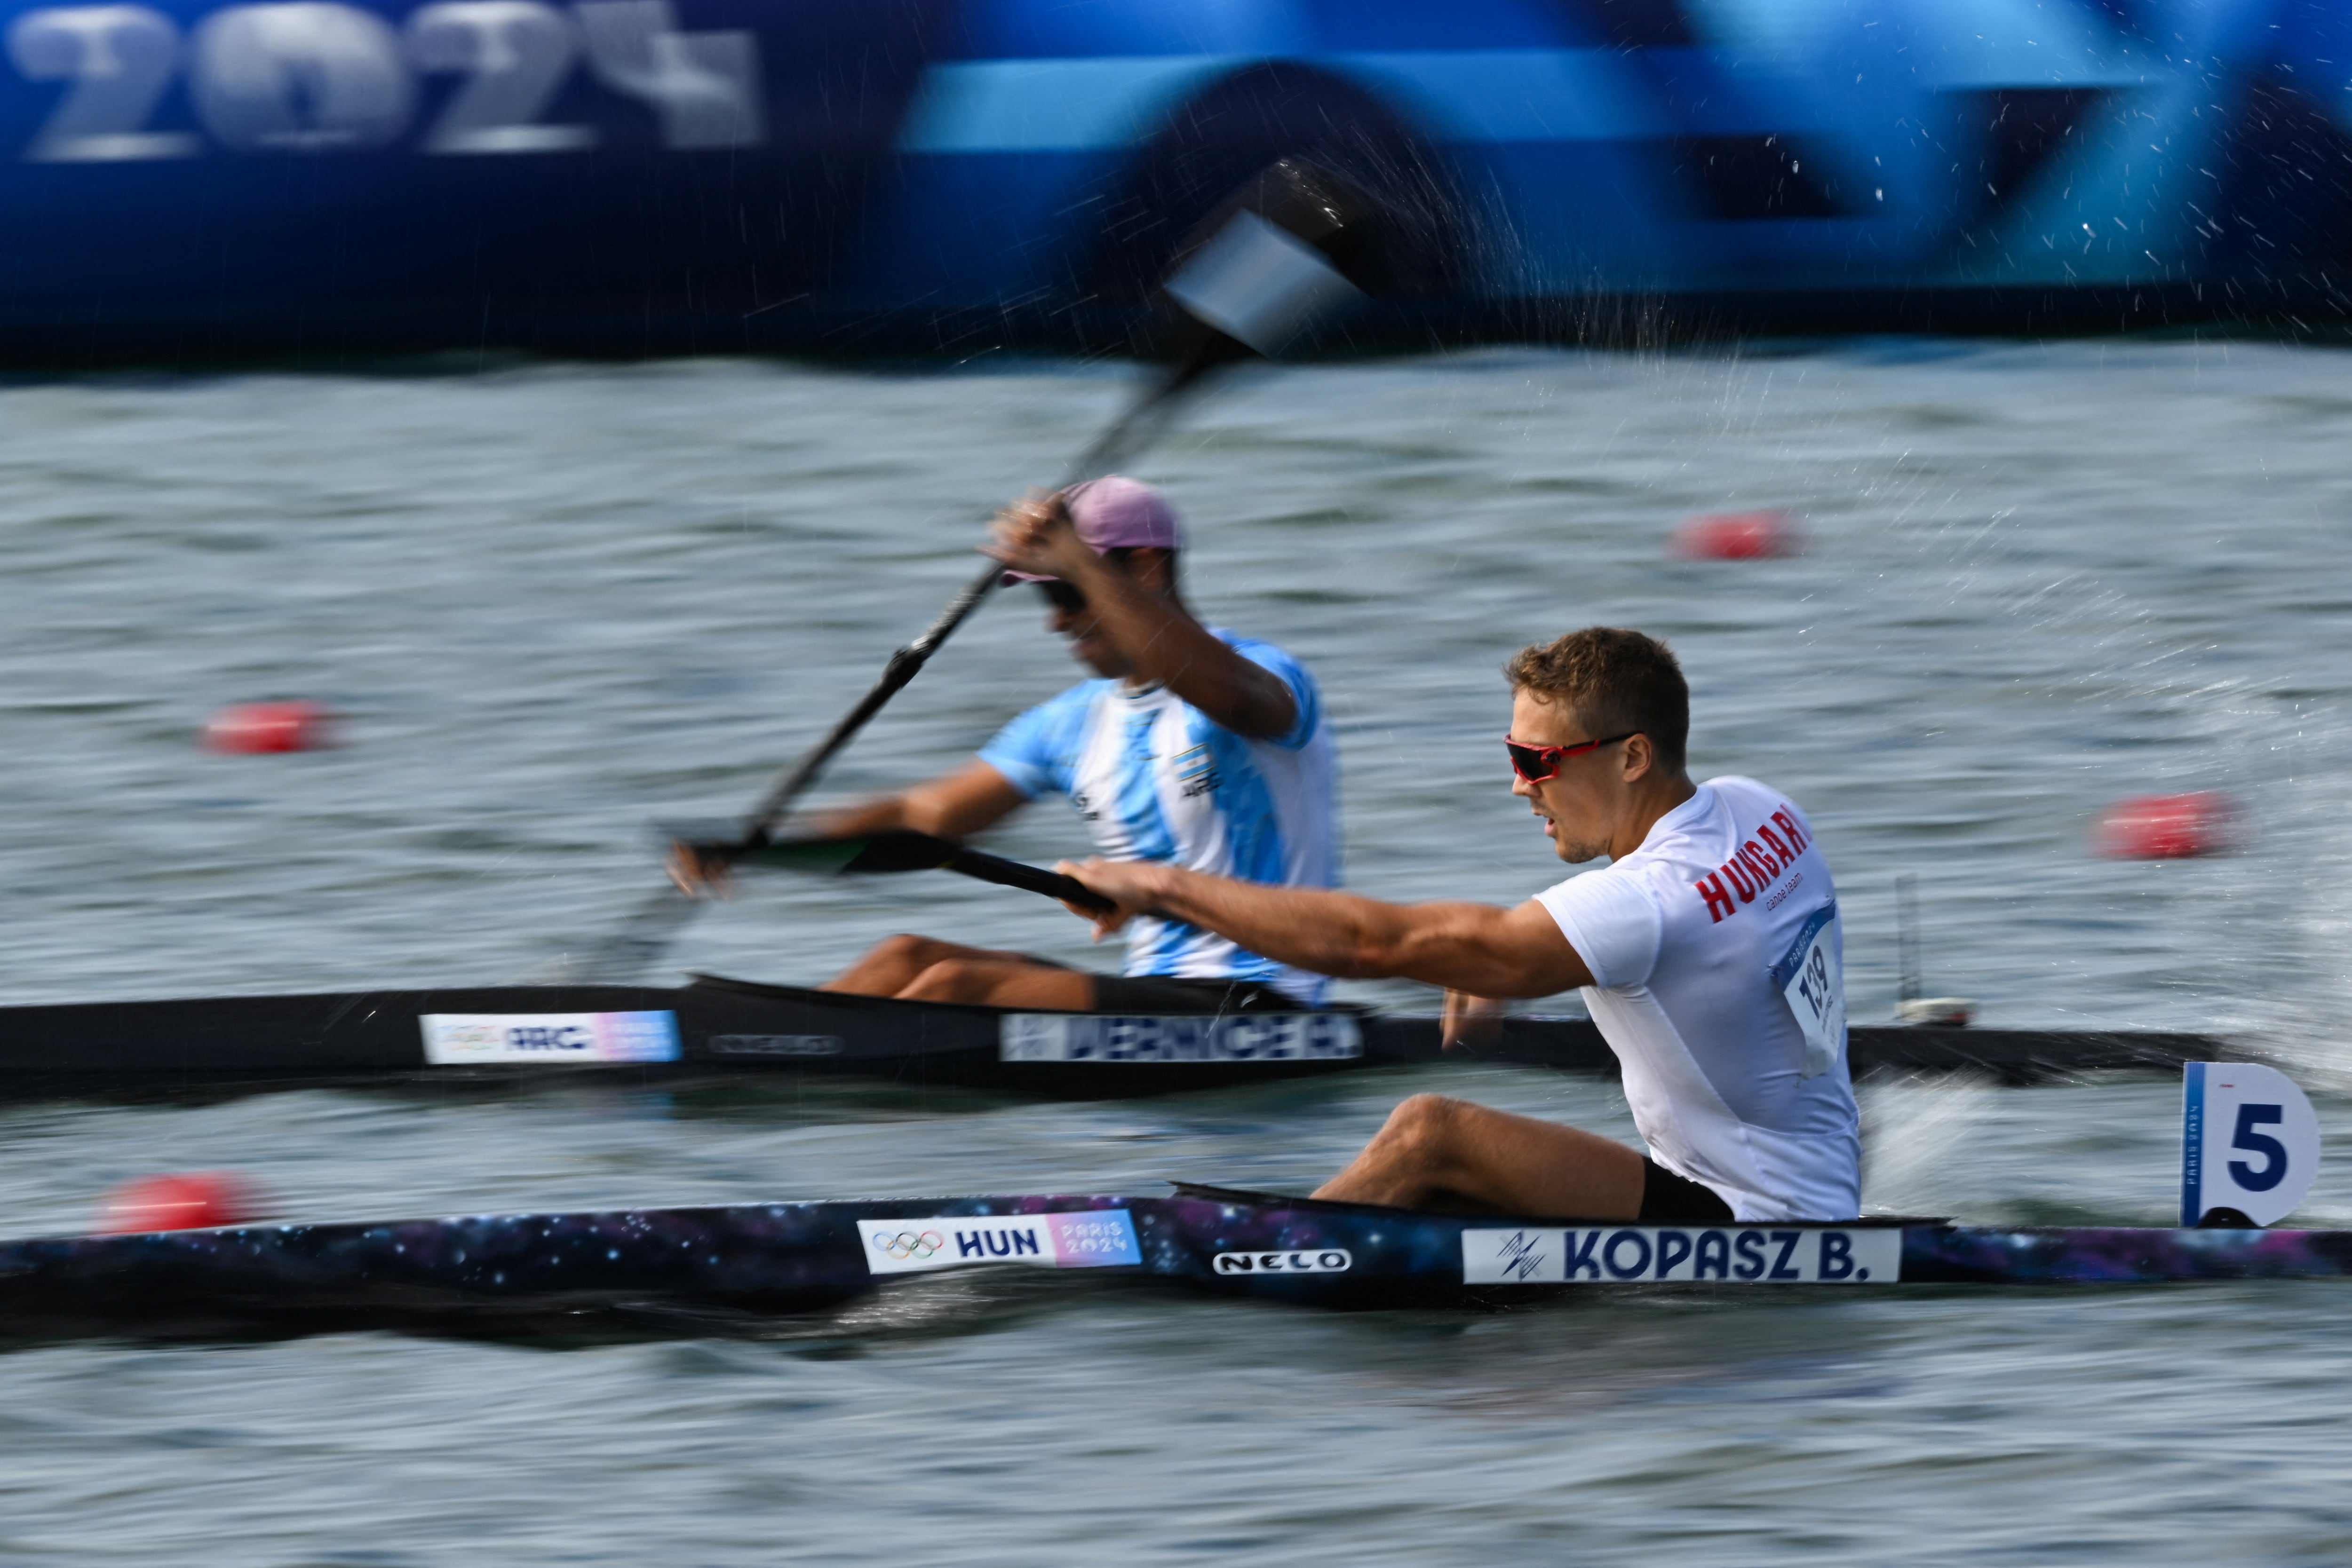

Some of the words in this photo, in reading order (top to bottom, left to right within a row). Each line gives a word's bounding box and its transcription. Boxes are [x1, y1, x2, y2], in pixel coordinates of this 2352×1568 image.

[6, 1, 764, 162] 2024
[1766, 889, 1787, 911] canoe
[1784, 872, 1803, 894] team
[1799, 944, 1828, 1021] 139
[2186, 1146, 2199, 1185] PARIS
[2226, 1103, 2288, 1192] 5
[954, 1228, 1041, 1259] HUN
[1061, 1221, 1123, 1239] PARIS
[1065, 1237, 1128, 1254] 2024
[1218, 1252, 1347, 1272] NELO
[1563, 1229, 1803, 1281] KOPASZ
[1817, 1231, 1871, 1282] B.
